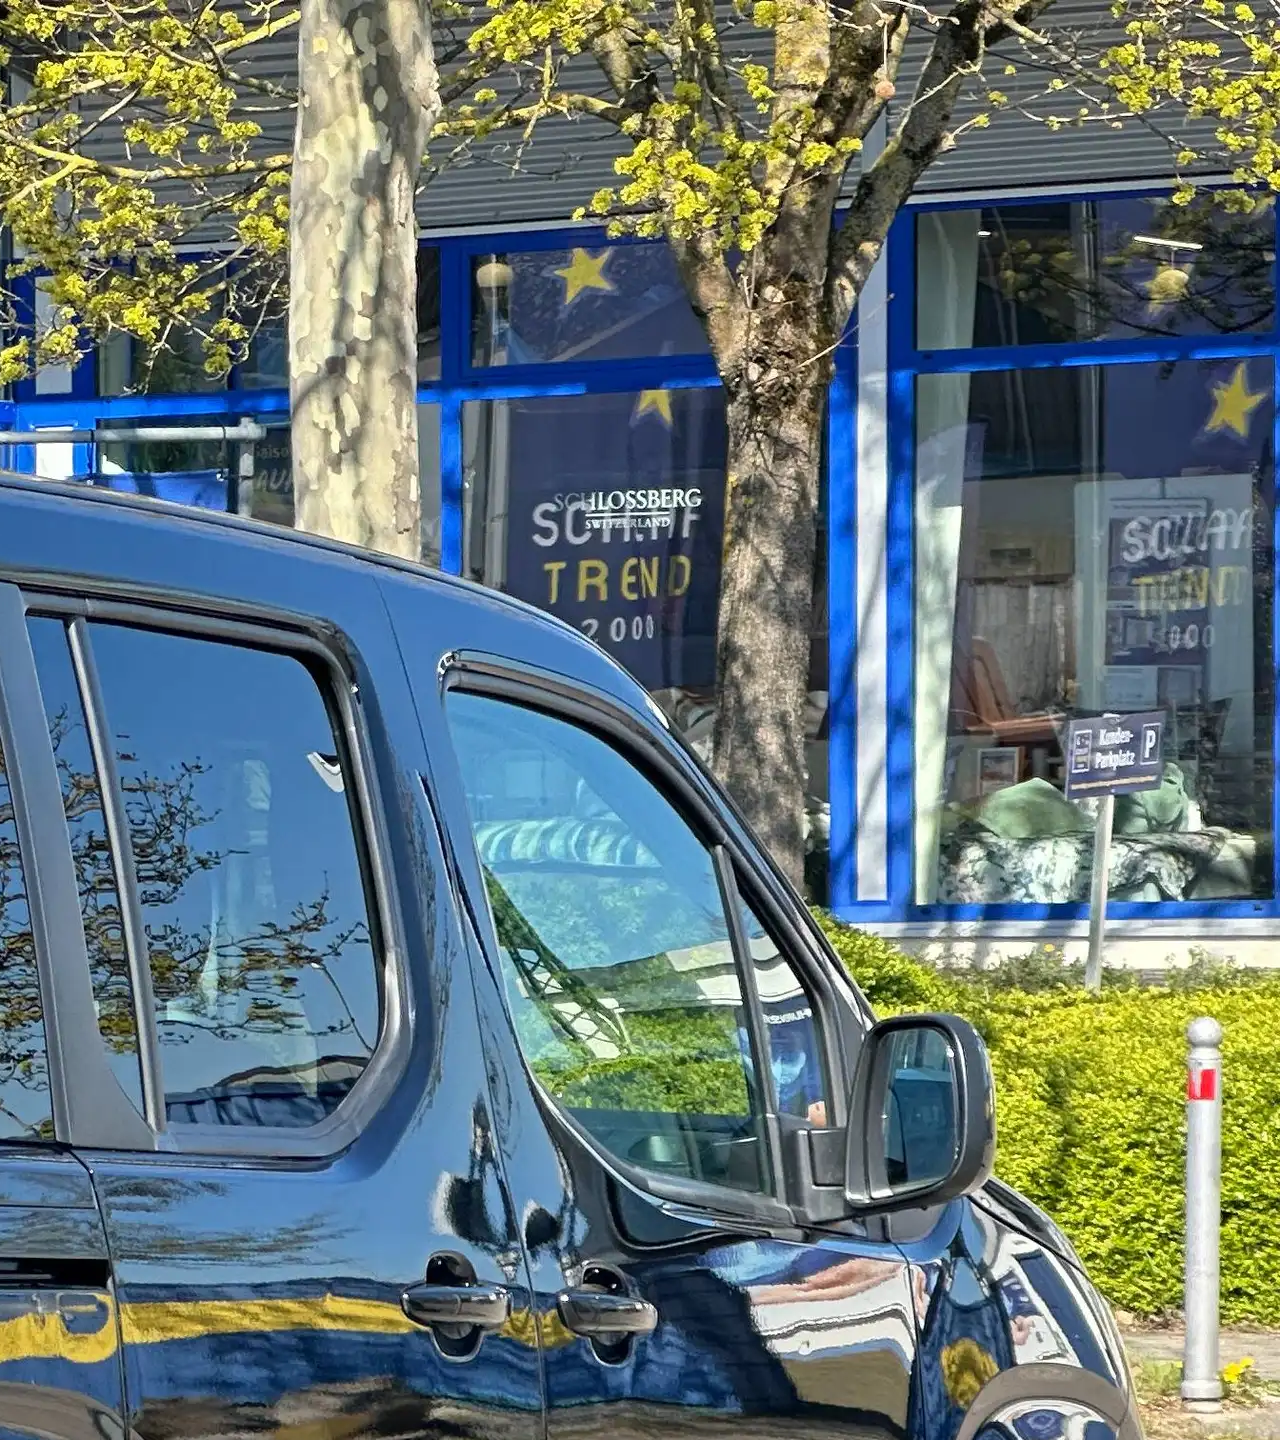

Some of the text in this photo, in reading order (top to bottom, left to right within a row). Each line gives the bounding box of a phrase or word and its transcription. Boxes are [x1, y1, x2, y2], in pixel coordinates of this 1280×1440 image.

[554, 488, 702, 512] SCHLOSSBERG
[585, 517, 671, 530] SWITZERLAND
[543, 555, 691, 604] TREND
[581, 615, 654, 643] 2000
[1095, 749, 1135, 771] Parkplatz
